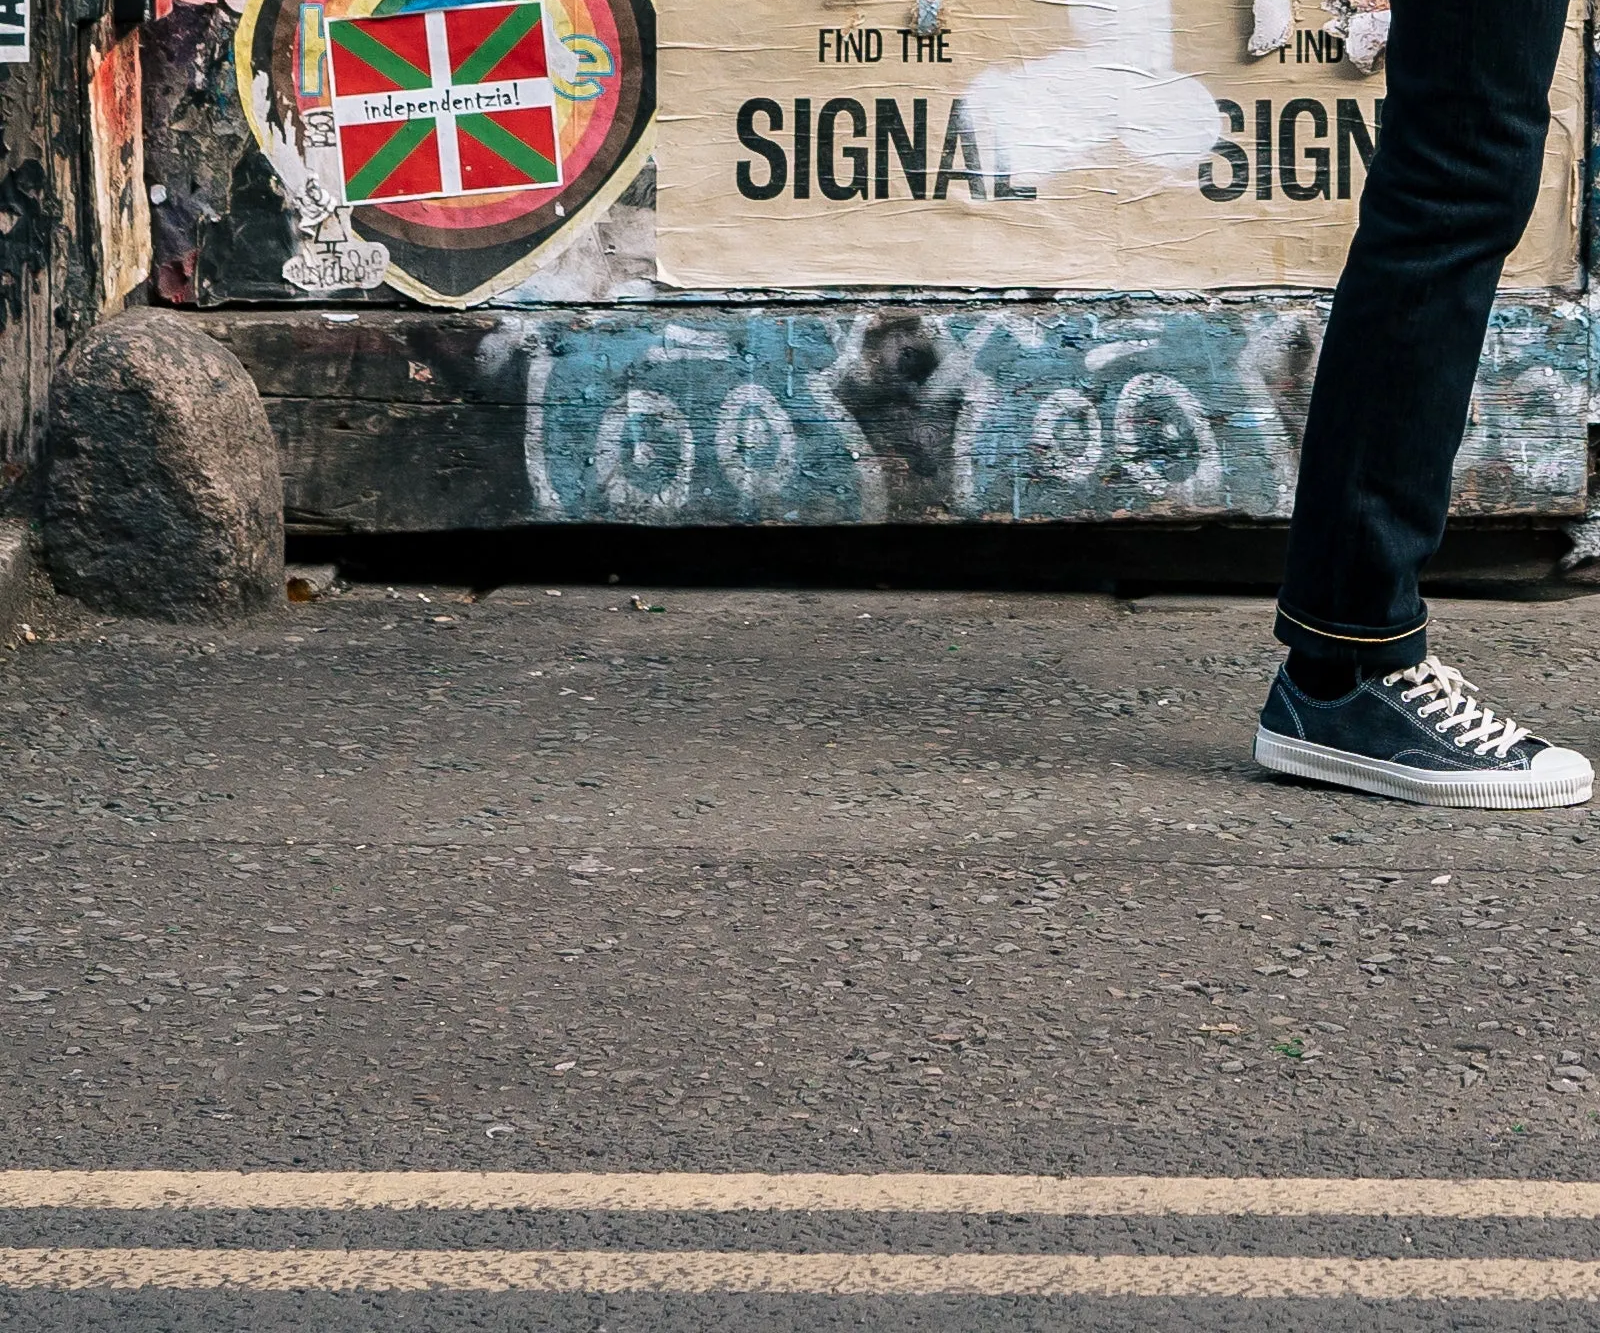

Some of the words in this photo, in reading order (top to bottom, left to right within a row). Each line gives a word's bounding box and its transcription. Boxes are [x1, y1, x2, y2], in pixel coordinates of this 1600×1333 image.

[819, 28, 883, 63] FIND
[897, 28, 953, 63] THE
[364, 83, 520, 122] independentzia!
